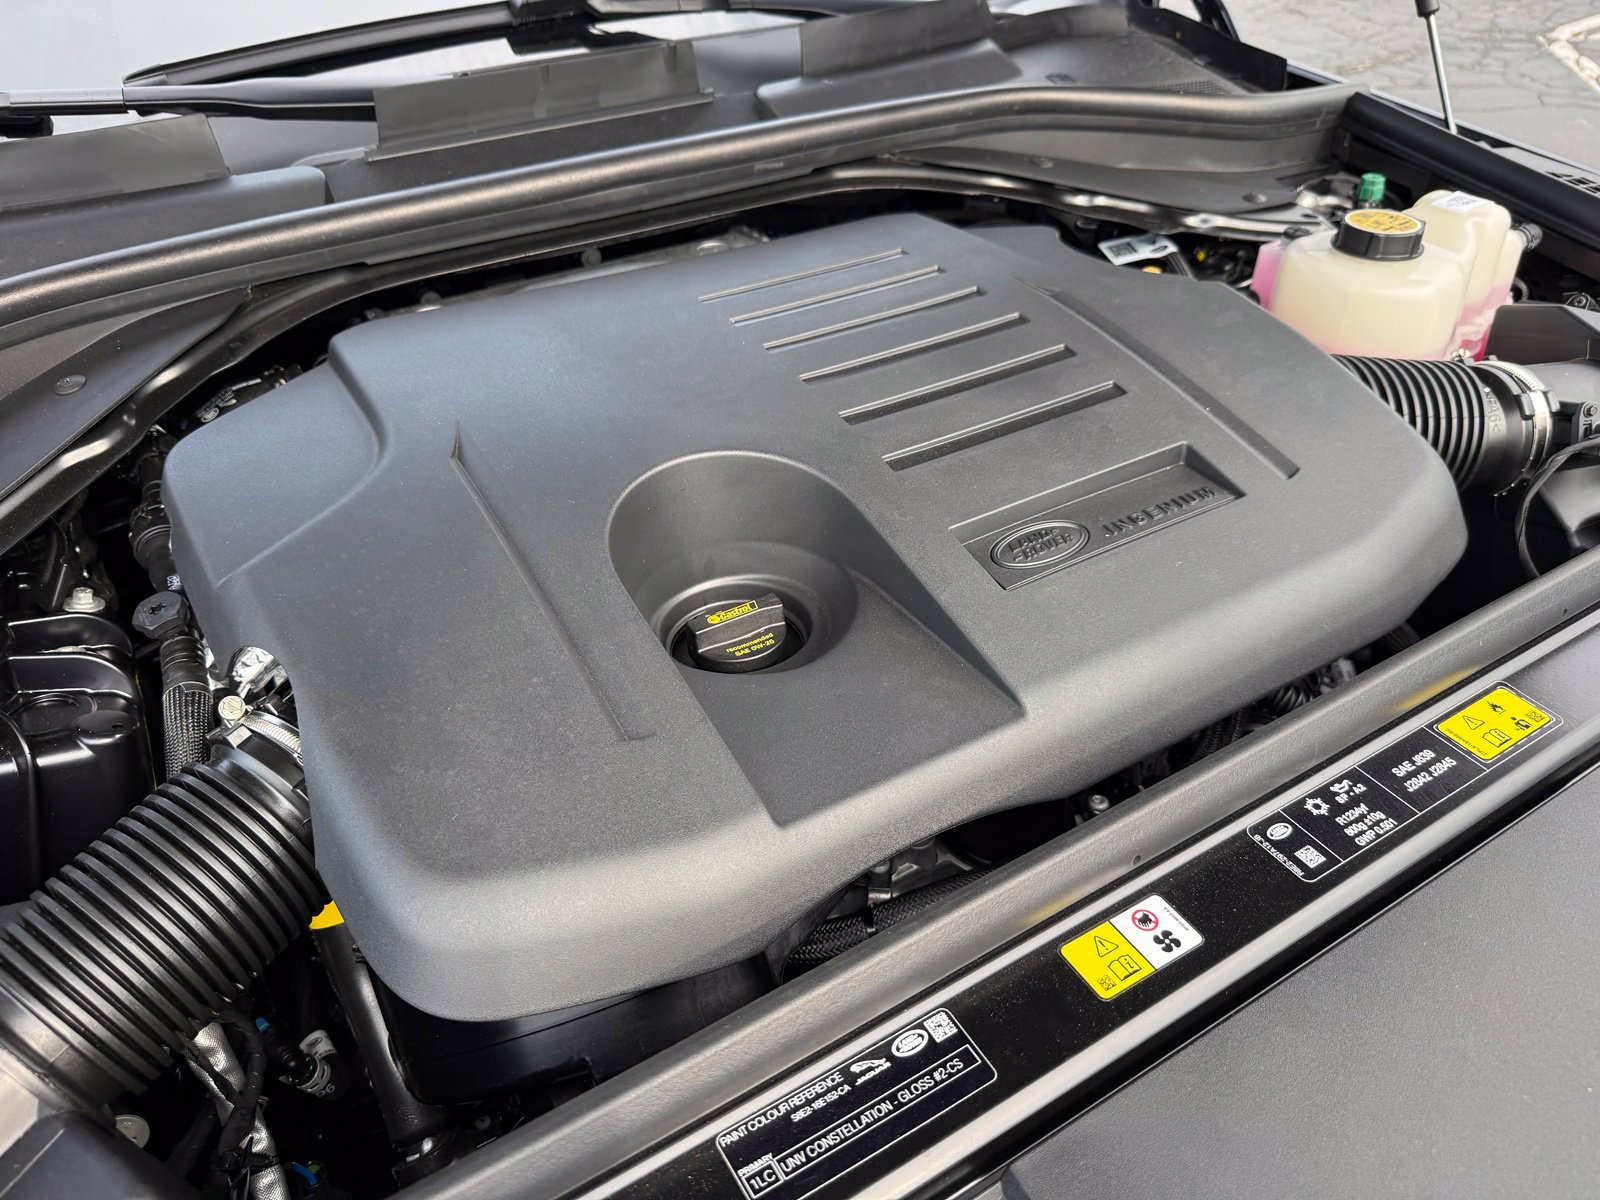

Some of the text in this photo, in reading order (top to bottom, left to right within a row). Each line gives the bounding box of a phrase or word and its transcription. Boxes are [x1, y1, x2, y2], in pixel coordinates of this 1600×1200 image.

[1007, 529, 1055, 553] LAND
[1022, 533, 1075, 560] ROVER
[719, 603, 752, 620] Castrol
[726, 632, 774, 653] recommended
[735, 649, 751, 657] SAE
[1391, 749, 1436, 777] SAE J639
[1403, 756, 1457, 792] J2842 J2845
[1352, 783, 1367, 794] A2
[1334, 802, 1370, 826] R1234yf
[1343, 811, 1387, 837] 800g ±10g
[1354, 817, 1398, 846] GWP 0.501
[855, 1061, 892, 1085] JAGUAR
[719, 1071, 845, 1148] PAINT COLOUR REFERENCE
[781, 1150, 808, 1174] UNV
[806, 1102, 894, 1158] CONSTELLATION
[899, 1078, 935, 1103] GLOSS
[932, 1058, 964, 1082] #2-CS
[737, 1152, 774, 1177] PRIMARY
[748, 1168, 777, 1190] 1LC
